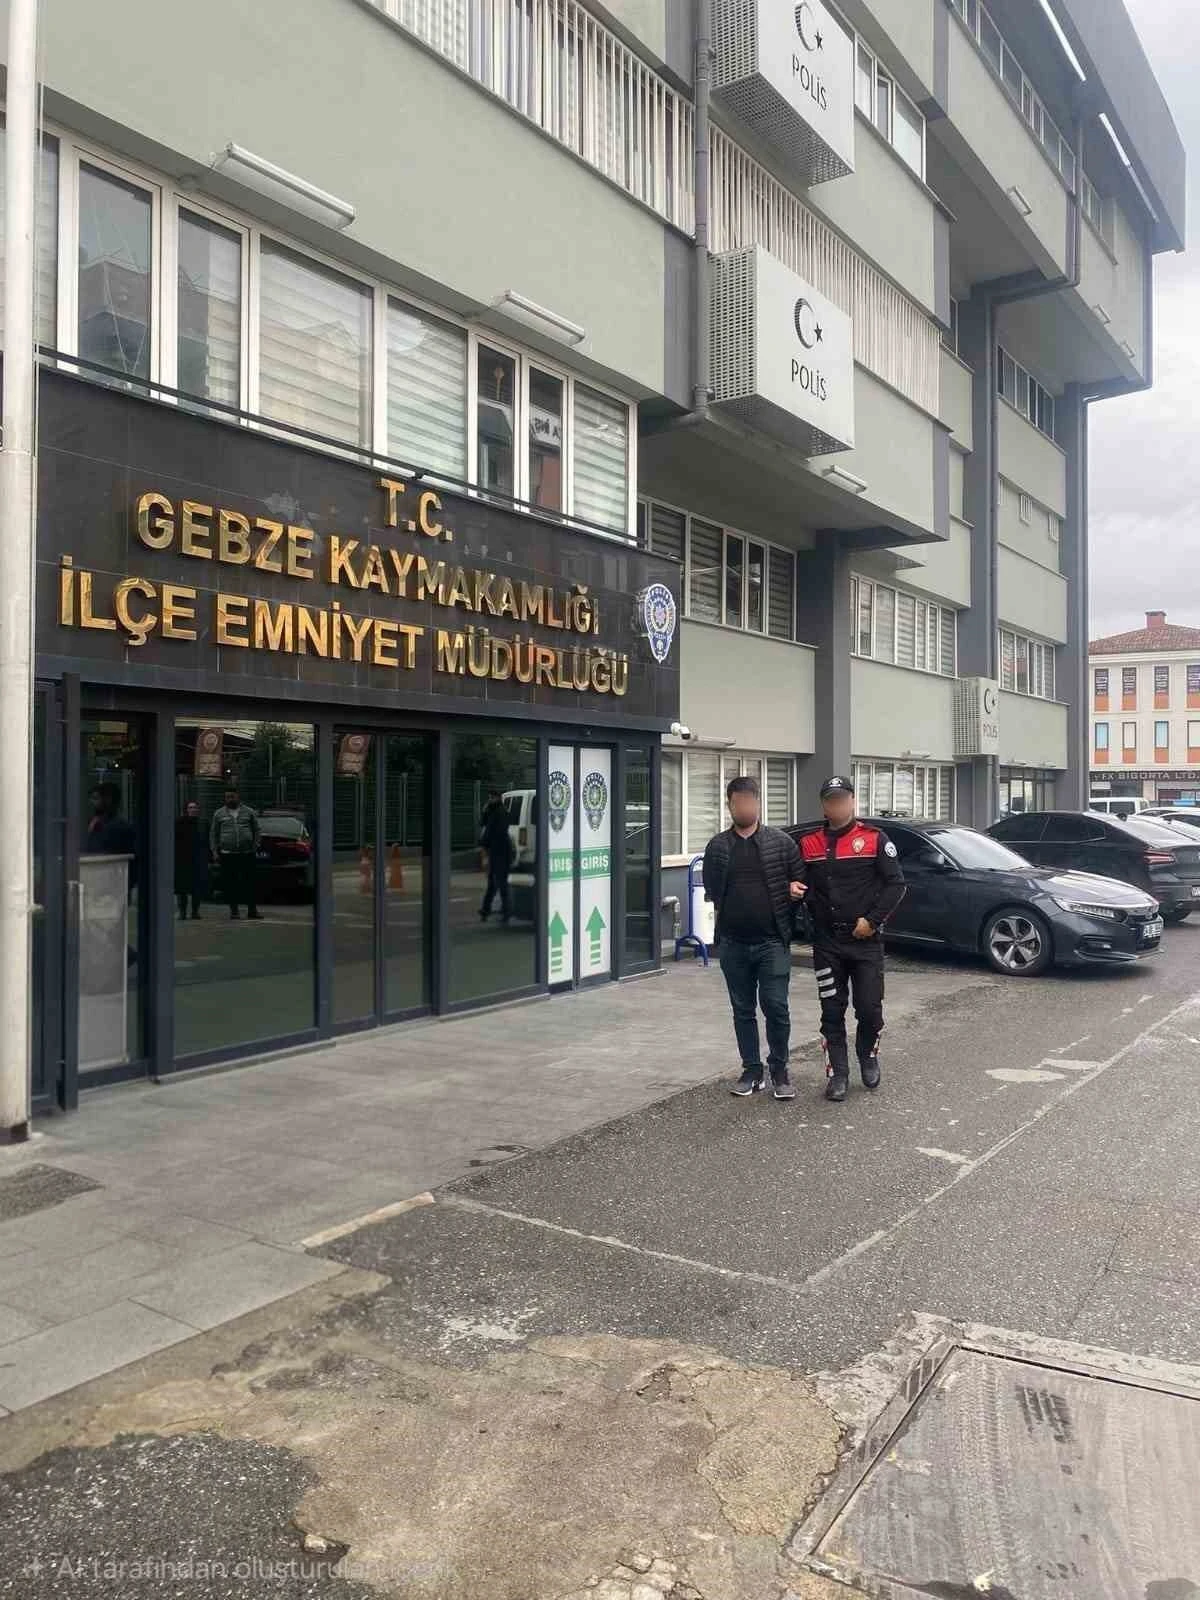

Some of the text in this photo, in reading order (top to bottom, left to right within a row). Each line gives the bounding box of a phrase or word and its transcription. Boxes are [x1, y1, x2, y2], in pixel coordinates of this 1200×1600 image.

[792, 54, 827, 111] POLİS
[791, 358, 827, 402] POLİS
[377, 478, 454, 541] T.C.
[135, 492, 600, 635] GEBZE KAYMAKAMLIĞI
[59, 554, 629, 697] İLÇE EMNİYET MÜDÜRLÜĞÜ
